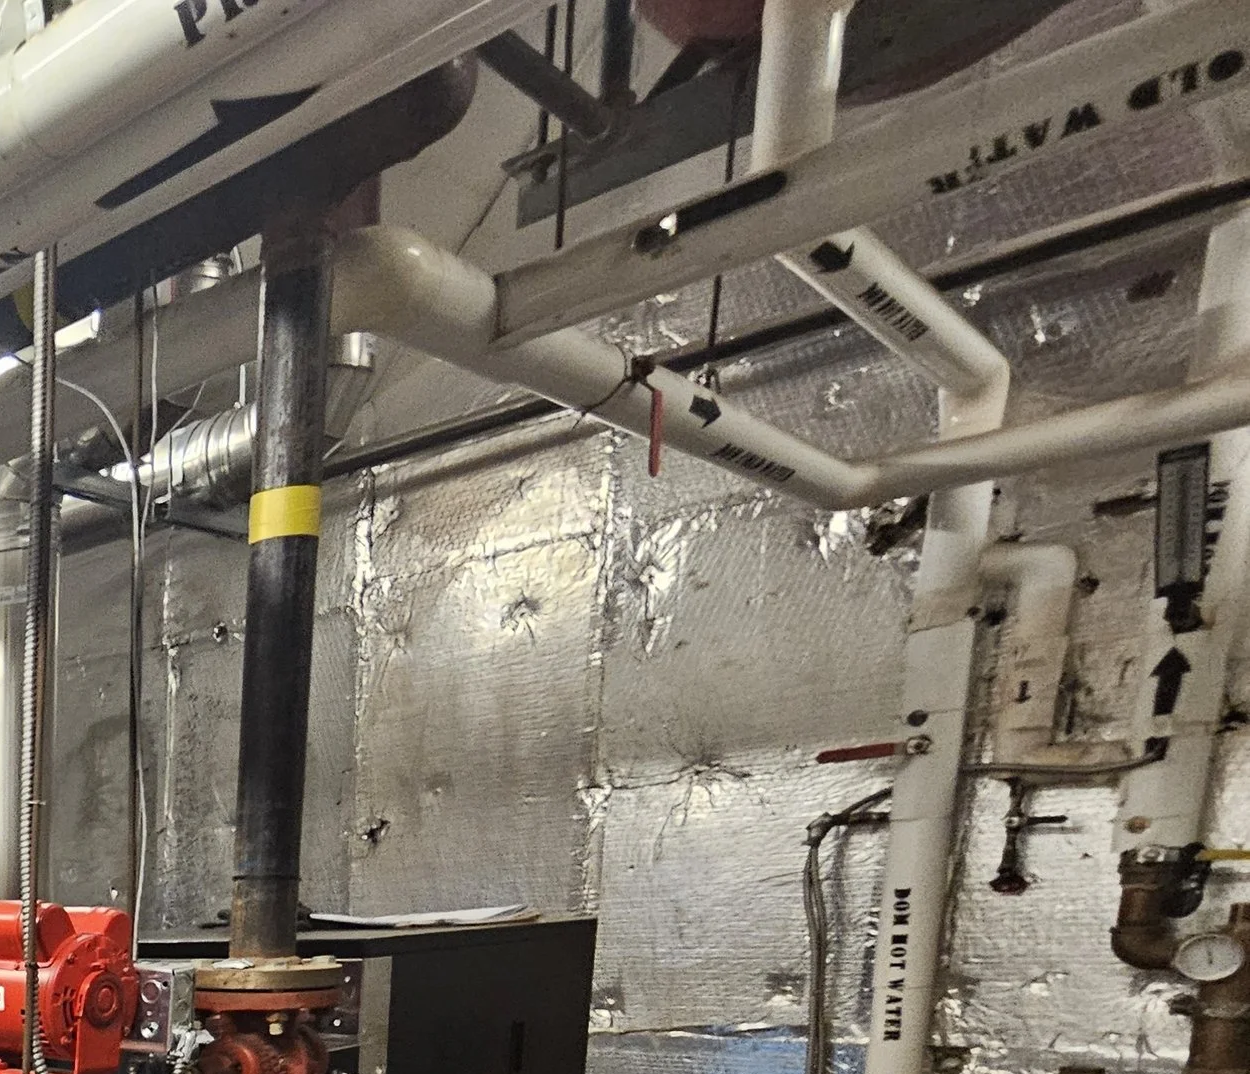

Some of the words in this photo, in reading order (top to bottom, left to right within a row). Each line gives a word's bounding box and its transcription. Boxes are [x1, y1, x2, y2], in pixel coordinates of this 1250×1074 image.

[892, 888, 912, 925] DOM
[889, 933, 909, 970] HOT
[883, 978, 905, 1041] WATER
